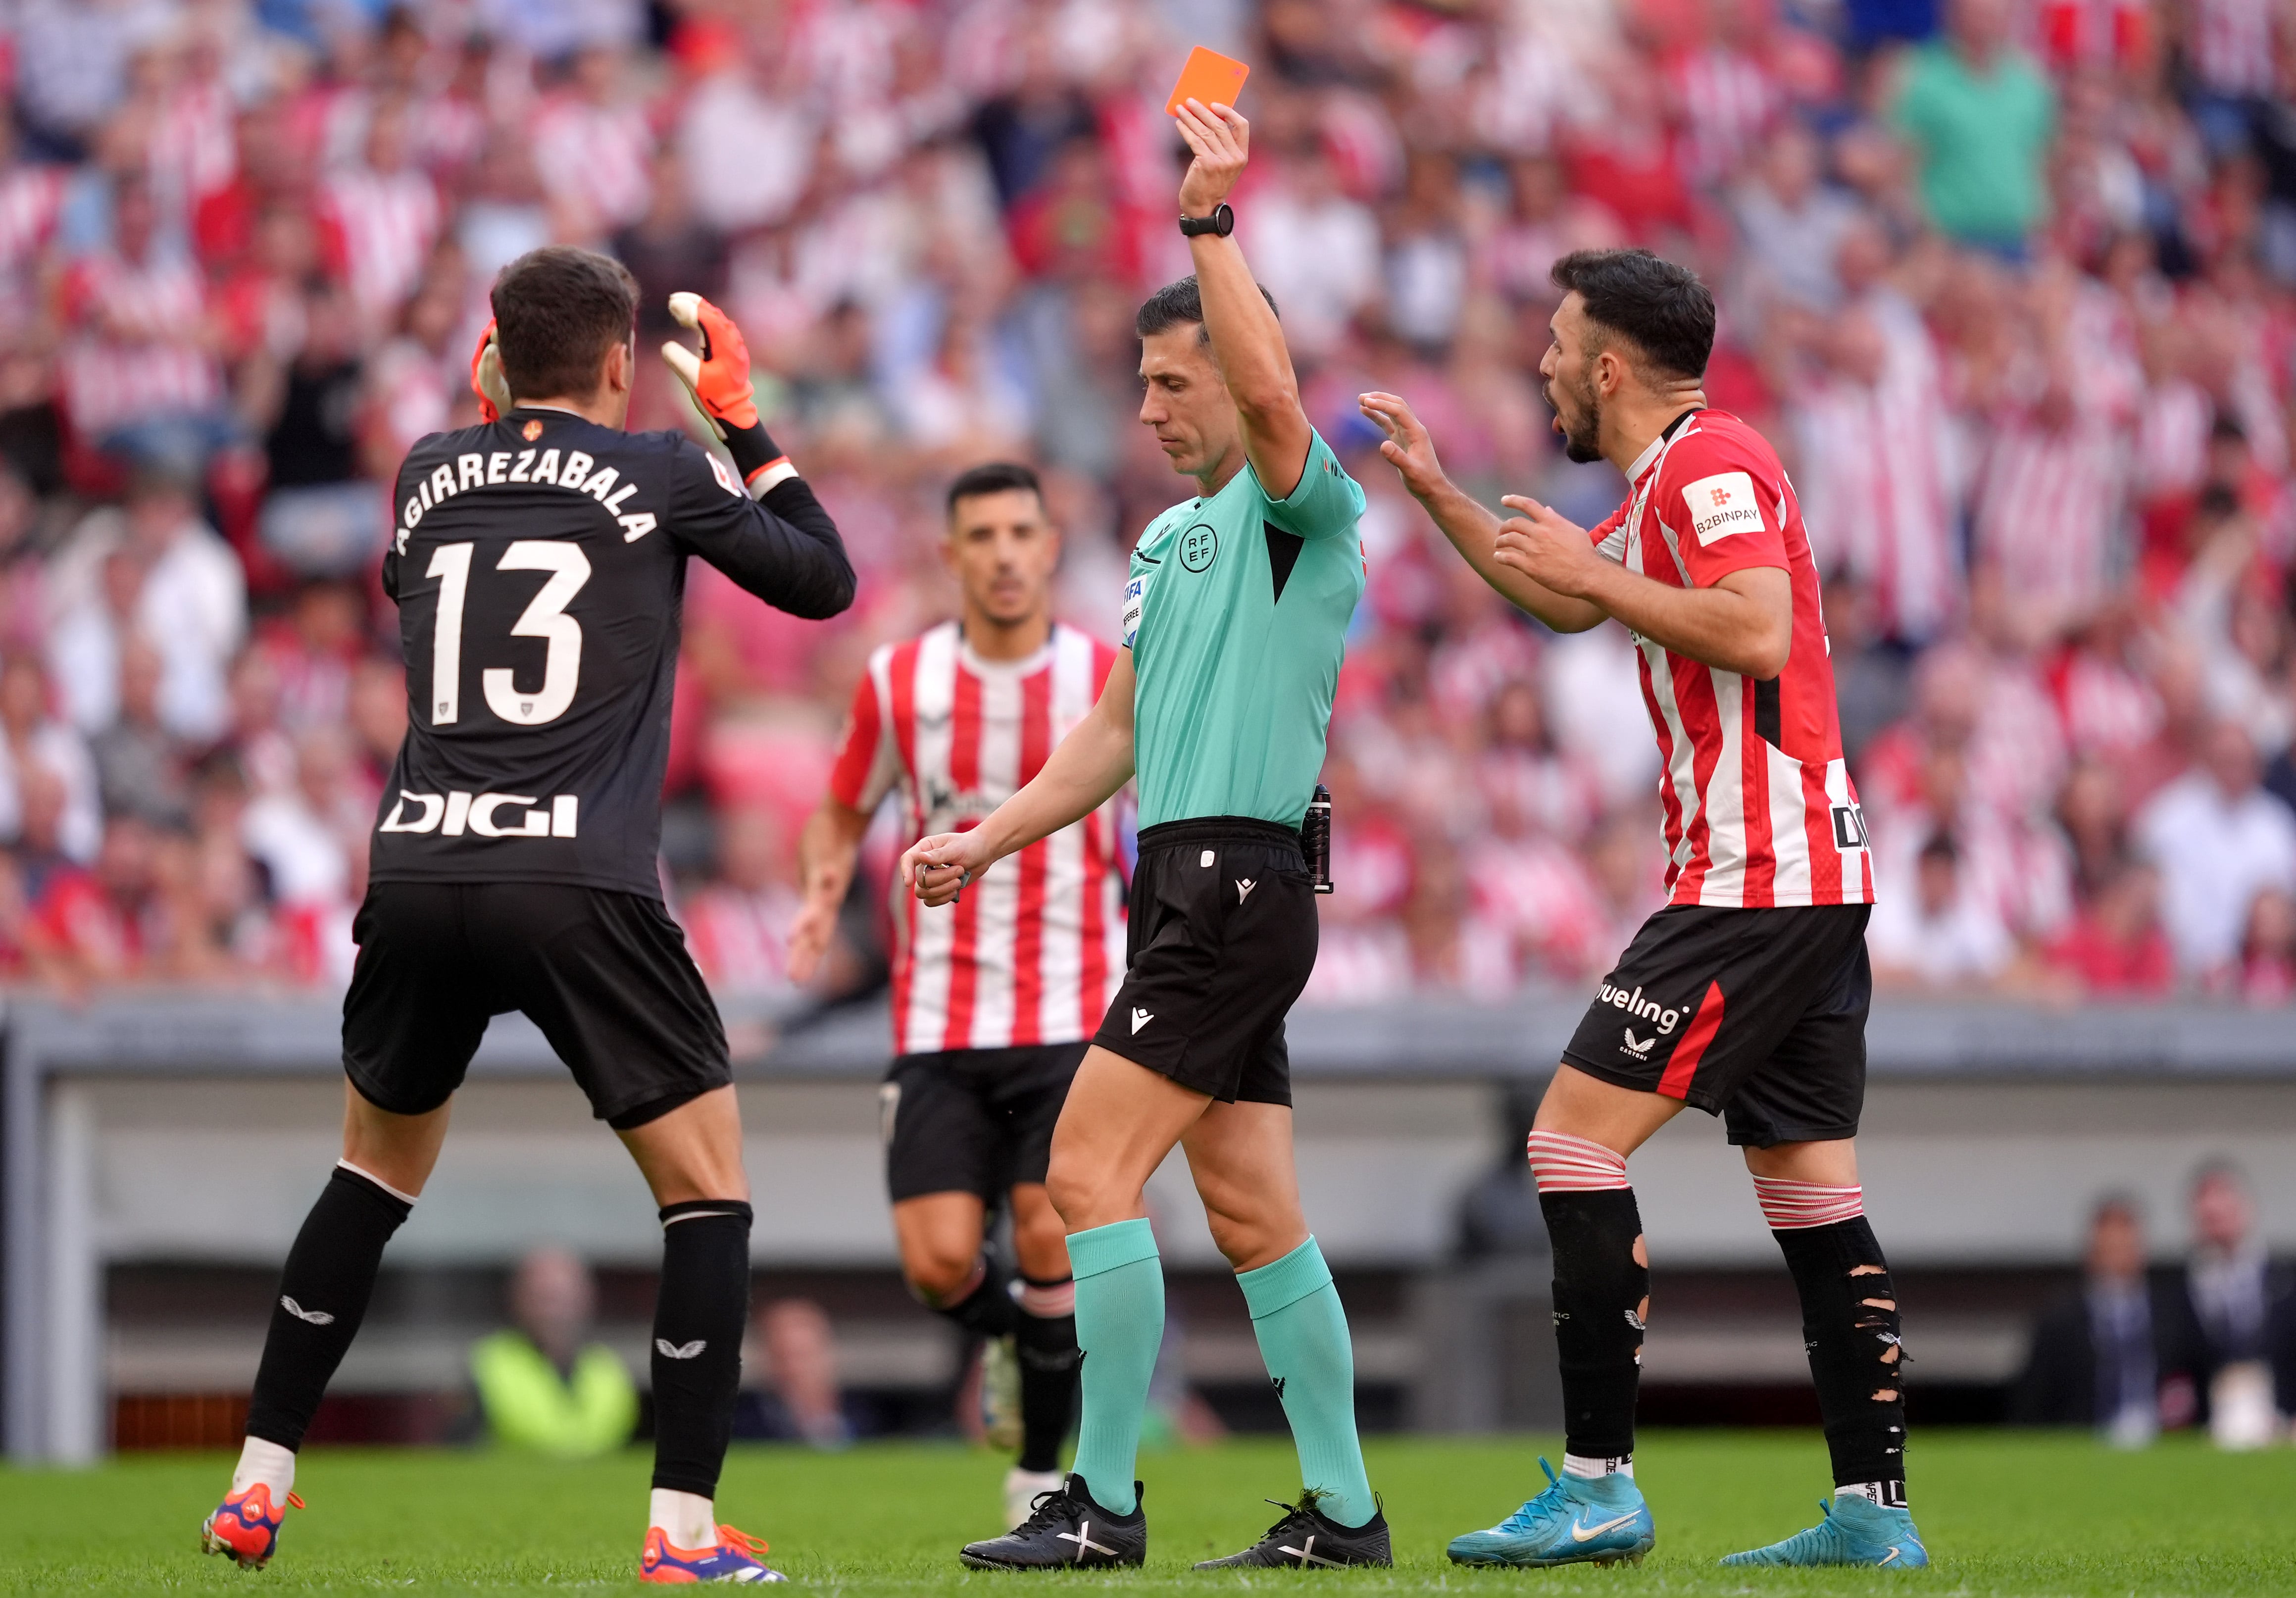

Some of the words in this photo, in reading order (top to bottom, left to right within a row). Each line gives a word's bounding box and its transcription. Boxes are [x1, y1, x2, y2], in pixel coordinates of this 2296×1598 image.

[396, 448, 657, 556] AGIRREZABALA
[1696, 509, 1757, 535] B2BINPAY
[425, 540, 592, 726] 13
[378, 789, 579, 838] DIGI
[1619, 1046, 1647, 1061] CASTORE
